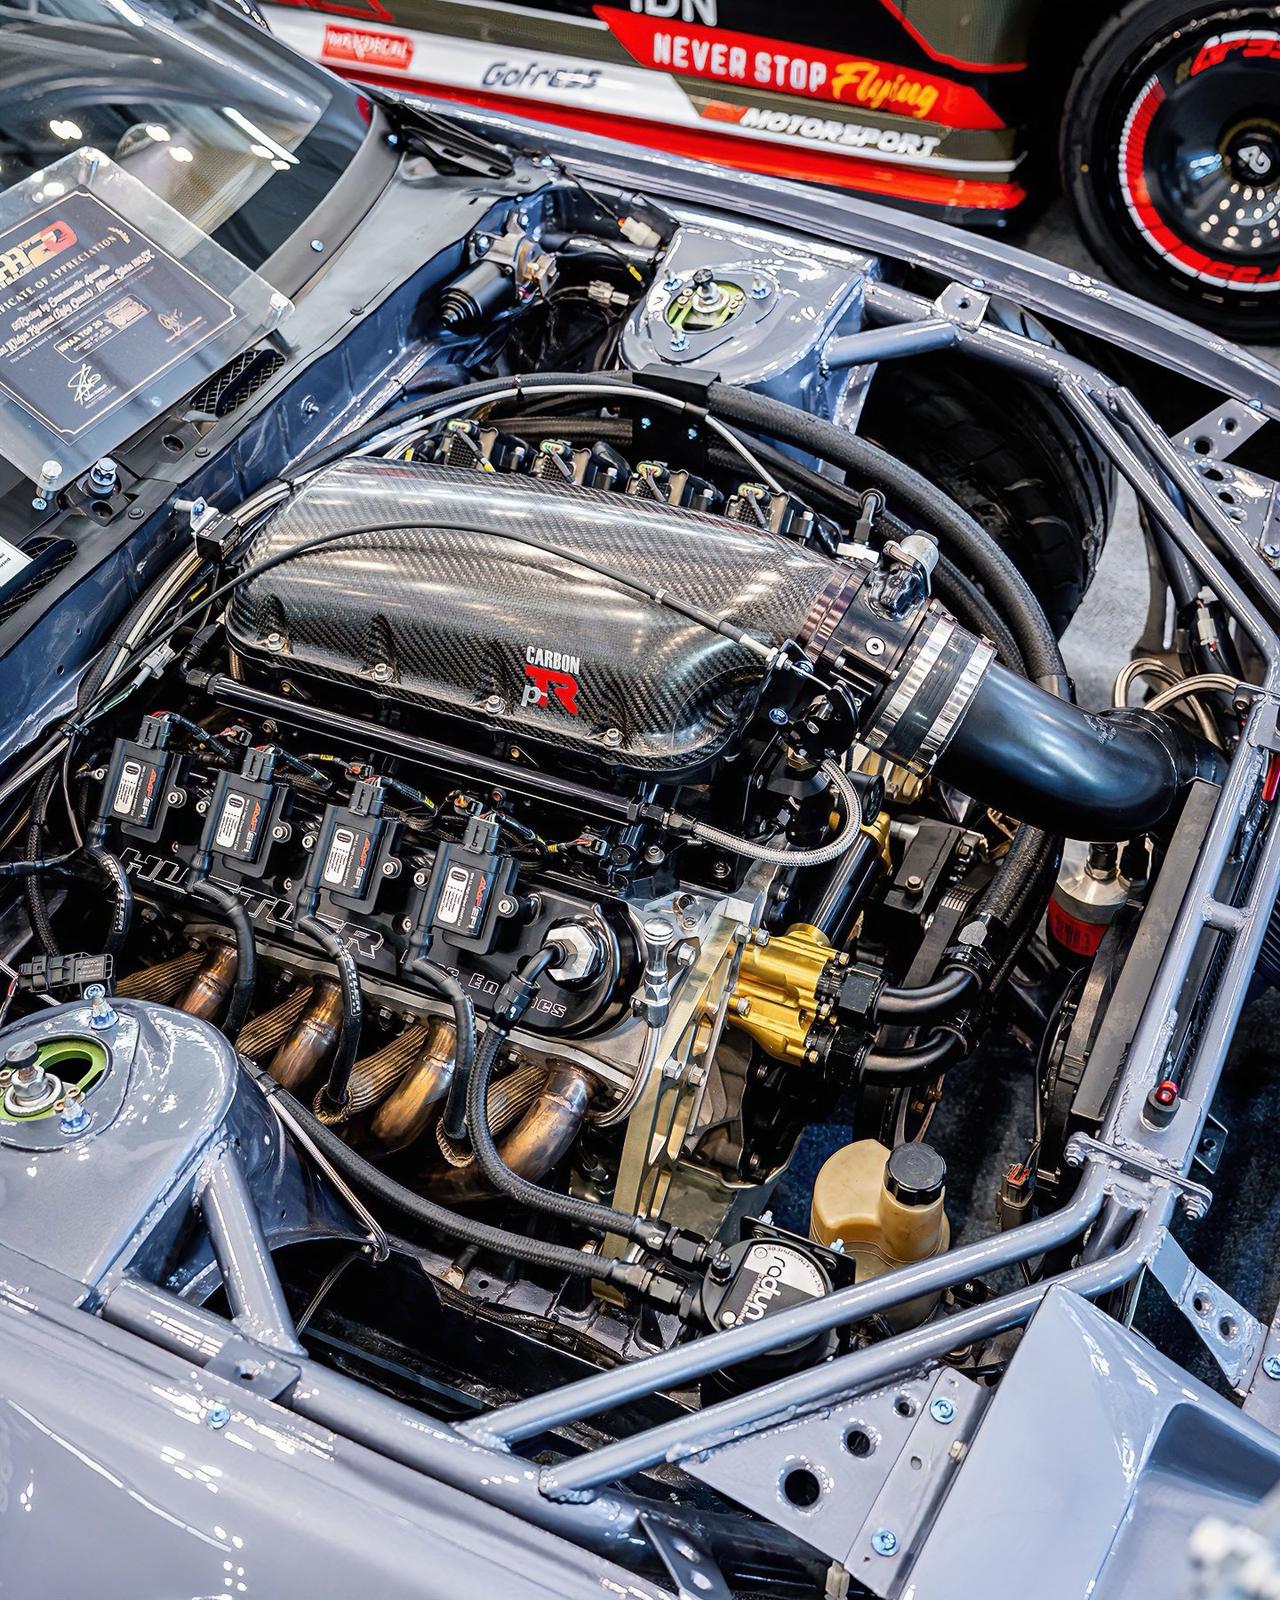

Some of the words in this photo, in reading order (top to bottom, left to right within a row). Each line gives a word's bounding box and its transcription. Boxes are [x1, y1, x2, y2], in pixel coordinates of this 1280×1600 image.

[653, 32, 747, 79] NEVER
[754, 51, 827, 92] STOP
[831, 61, 939, 118] Flying
[740, 107, 941, 158] MOTORSPORT
[51, 235, 117, 280] APPRECIATION
[526, 646, 580, 675] CARBON
